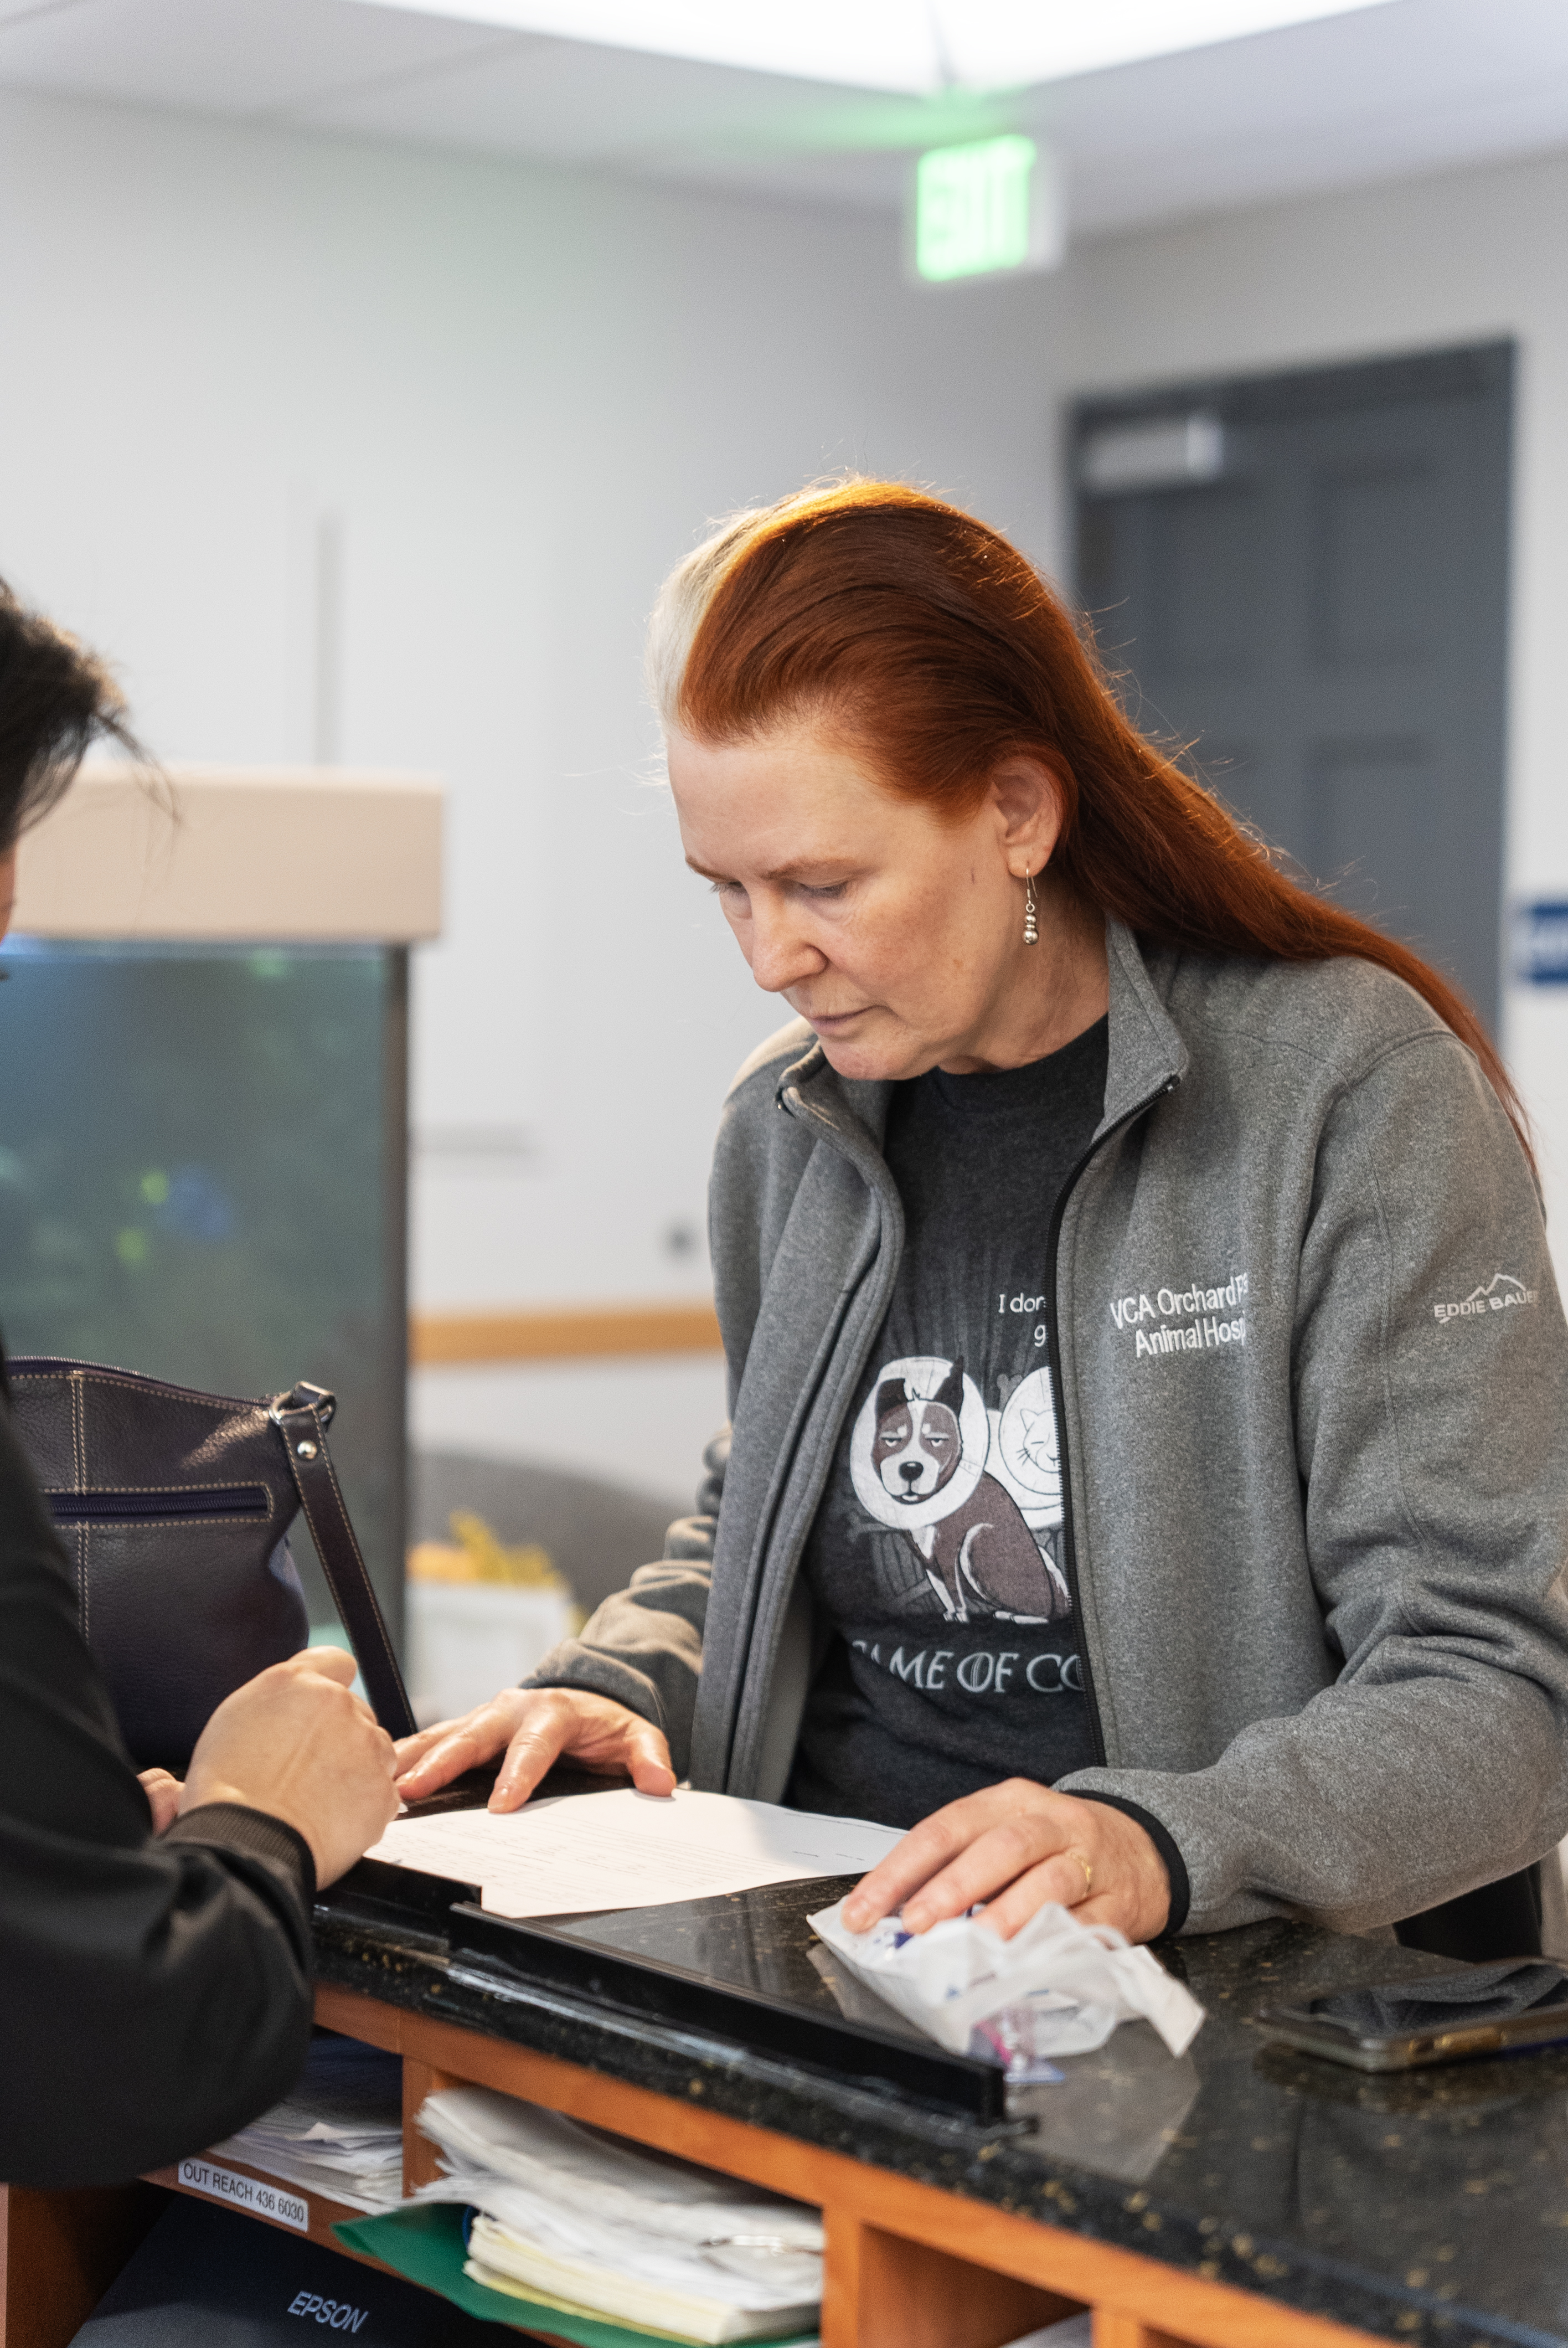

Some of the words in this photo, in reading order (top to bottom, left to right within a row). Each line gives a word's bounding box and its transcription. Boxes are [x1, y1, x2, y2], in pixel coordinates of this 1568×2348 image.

[998, 1293, 1005, 1313] I
[1110, 1294, 1156, 1329] VCA
[1157, 1275, 1236, 1315] Orchard
[1434, 1300, 1486, 1317] EDDIE
[1136, 1316, 1203, 1357] Animal
[957, 1651, 1019, 1693] OF
[183, 2162, 209, 2185] OUT
[213, 2172, 253, 2202] REACH
[256, 2189, 275, 2211] 436
[278, 2197, 305, 2223] 6030
[287, 2291, 369, 2334] EPSON
